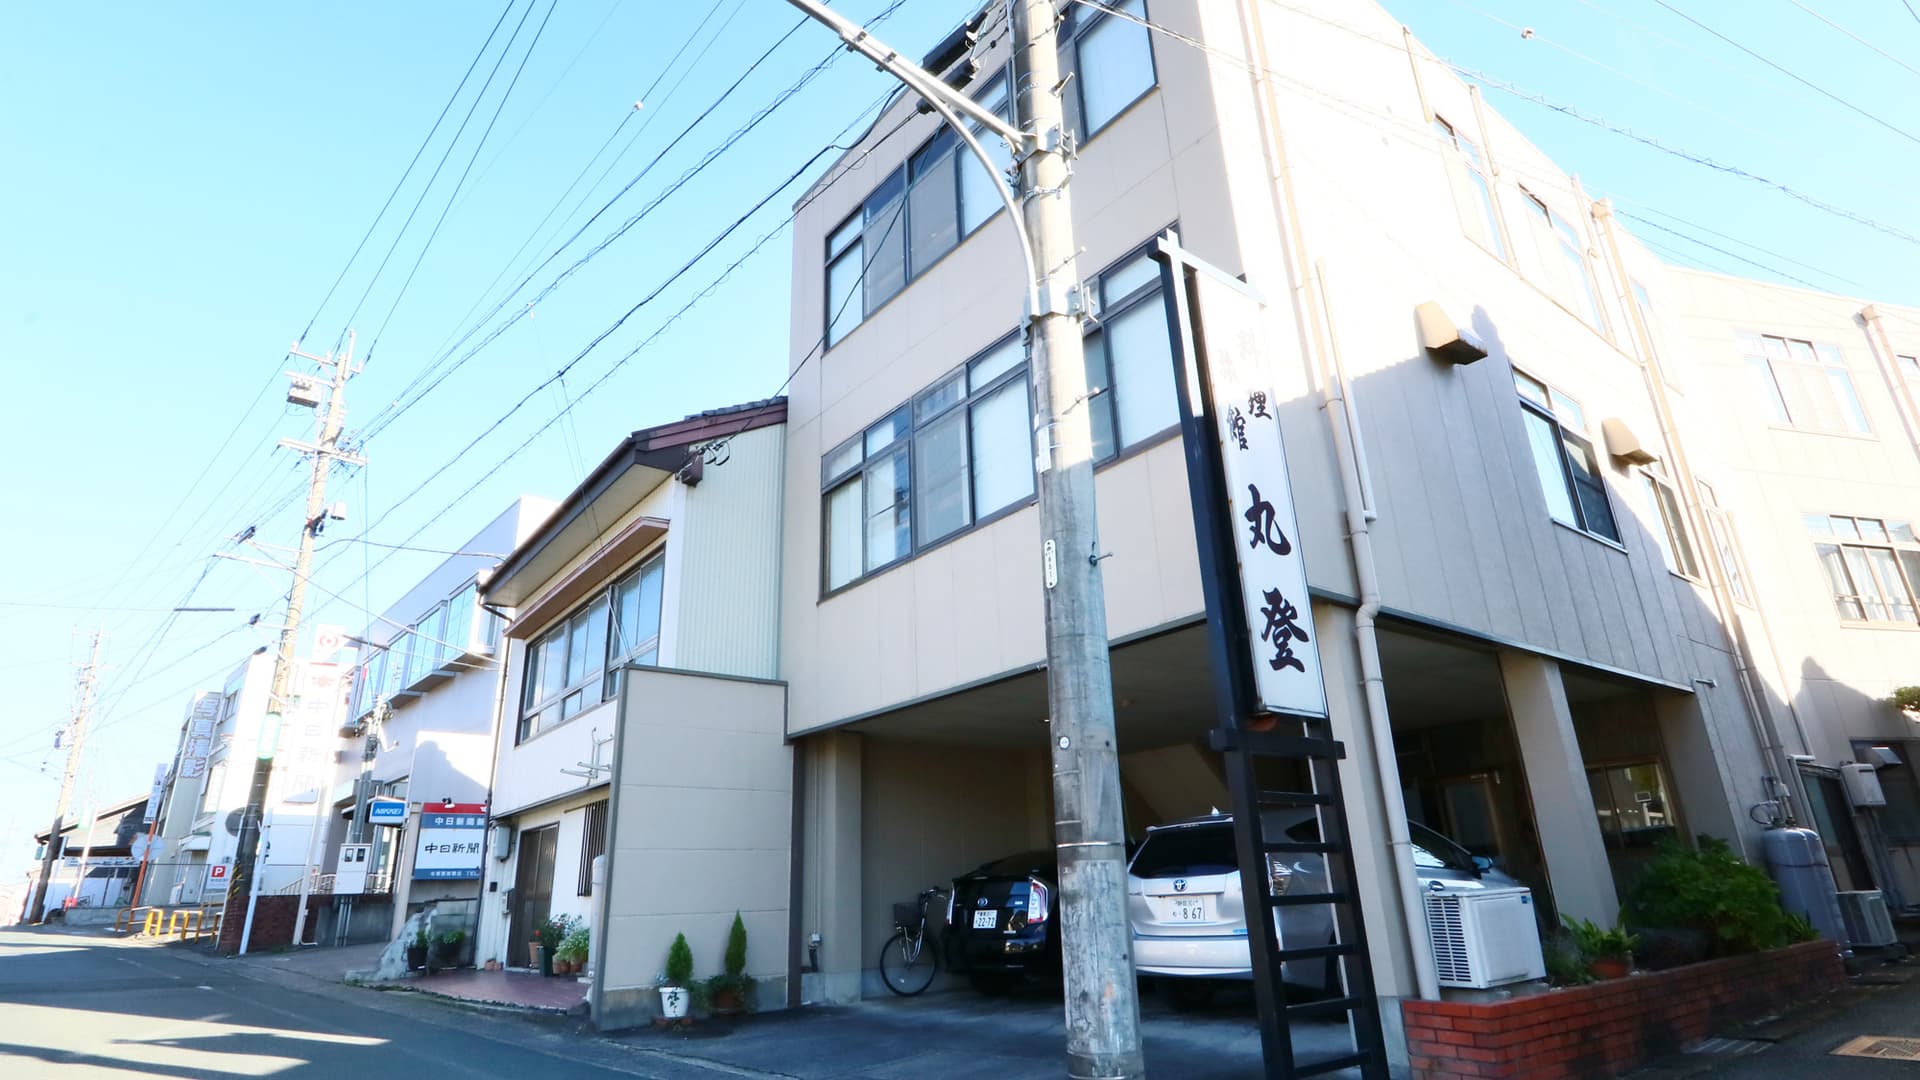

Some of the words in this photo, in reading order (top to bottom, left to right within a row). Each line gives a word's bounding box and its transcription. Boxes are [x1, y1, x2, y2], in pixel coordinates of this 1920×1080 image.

[424, 842, 480, 854] 中日新聞
[214, 867, 223, 876] P
